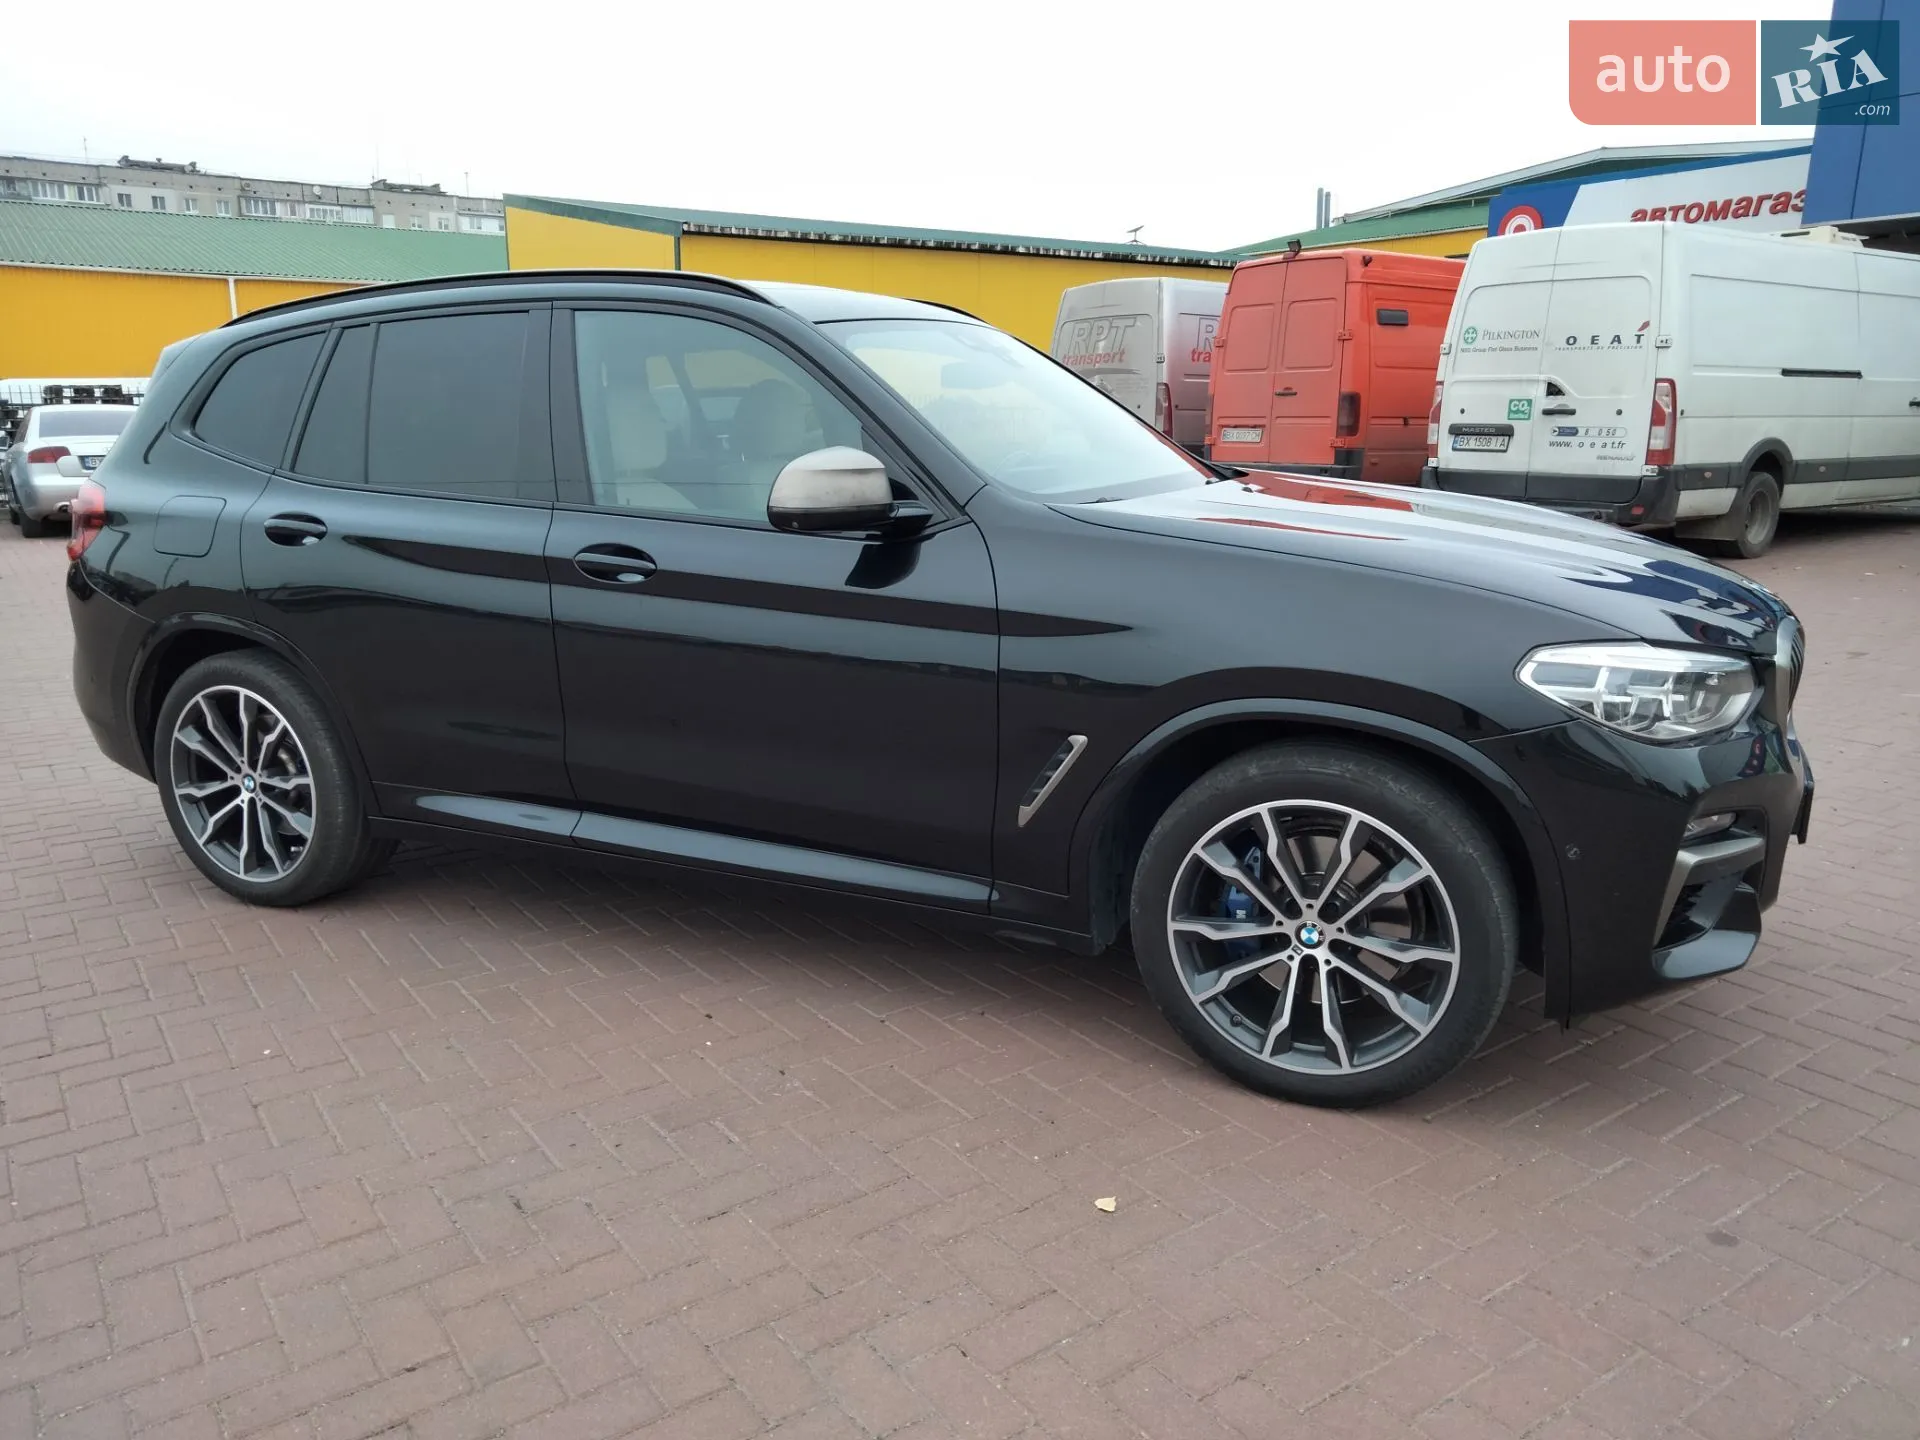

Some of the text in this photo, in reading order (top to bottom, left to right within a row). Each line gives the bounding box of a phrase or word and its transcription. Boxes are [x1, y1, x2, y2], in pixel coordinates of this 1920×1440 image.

[1067, 317, 1137, 355] RPT
[1481, 328, 1542, 341] PILKINGTON
[1062, 348, 1126, 368] transport
